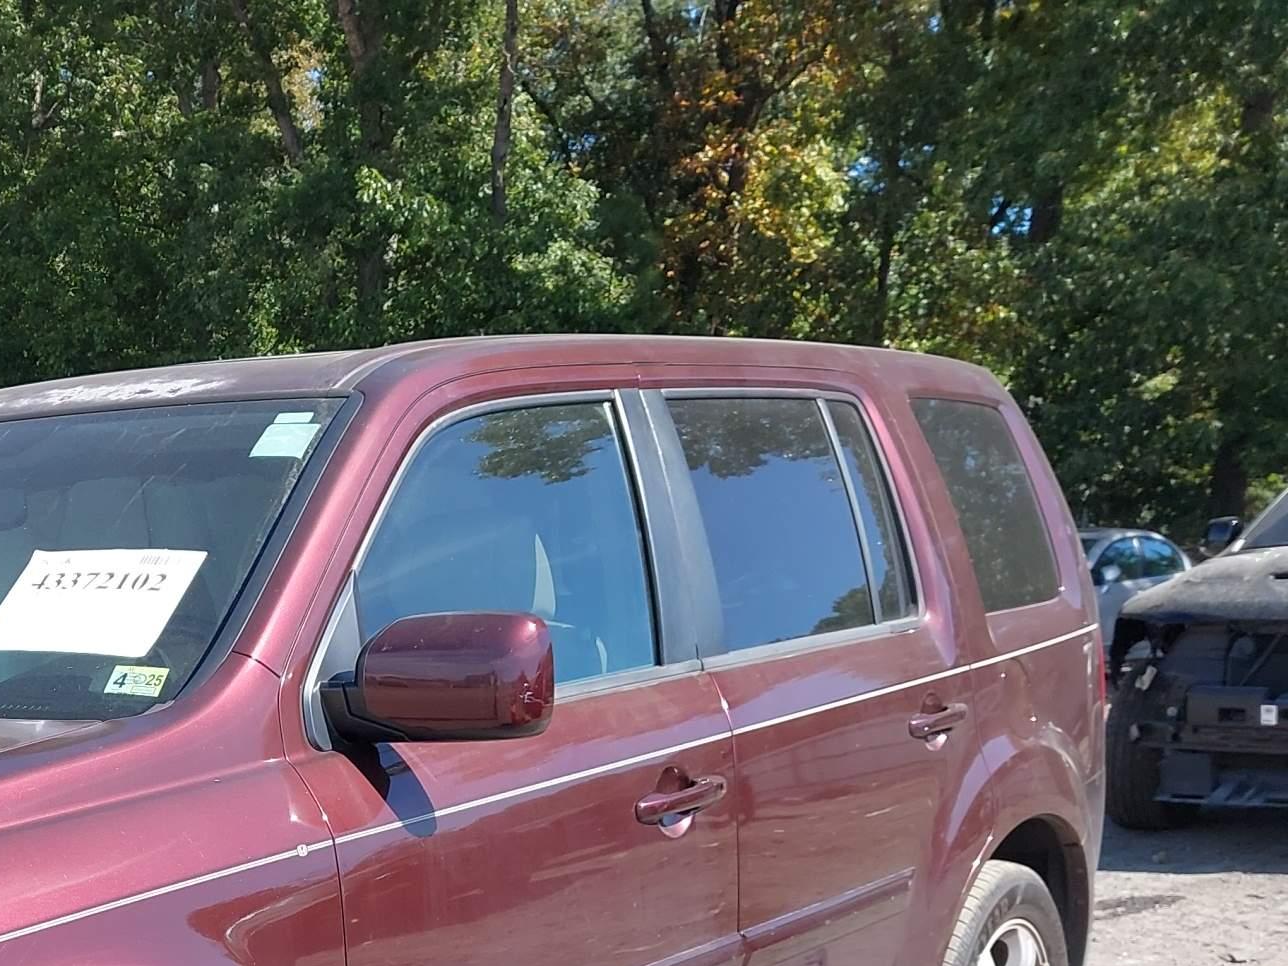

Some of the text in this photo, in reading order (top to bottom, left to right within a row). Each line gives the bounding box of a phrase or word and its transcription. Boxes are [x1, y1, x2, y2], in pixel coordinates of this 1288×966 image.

[31, 572, 168, 592] 43372102
[113, 672, 165, 689] 4 25
